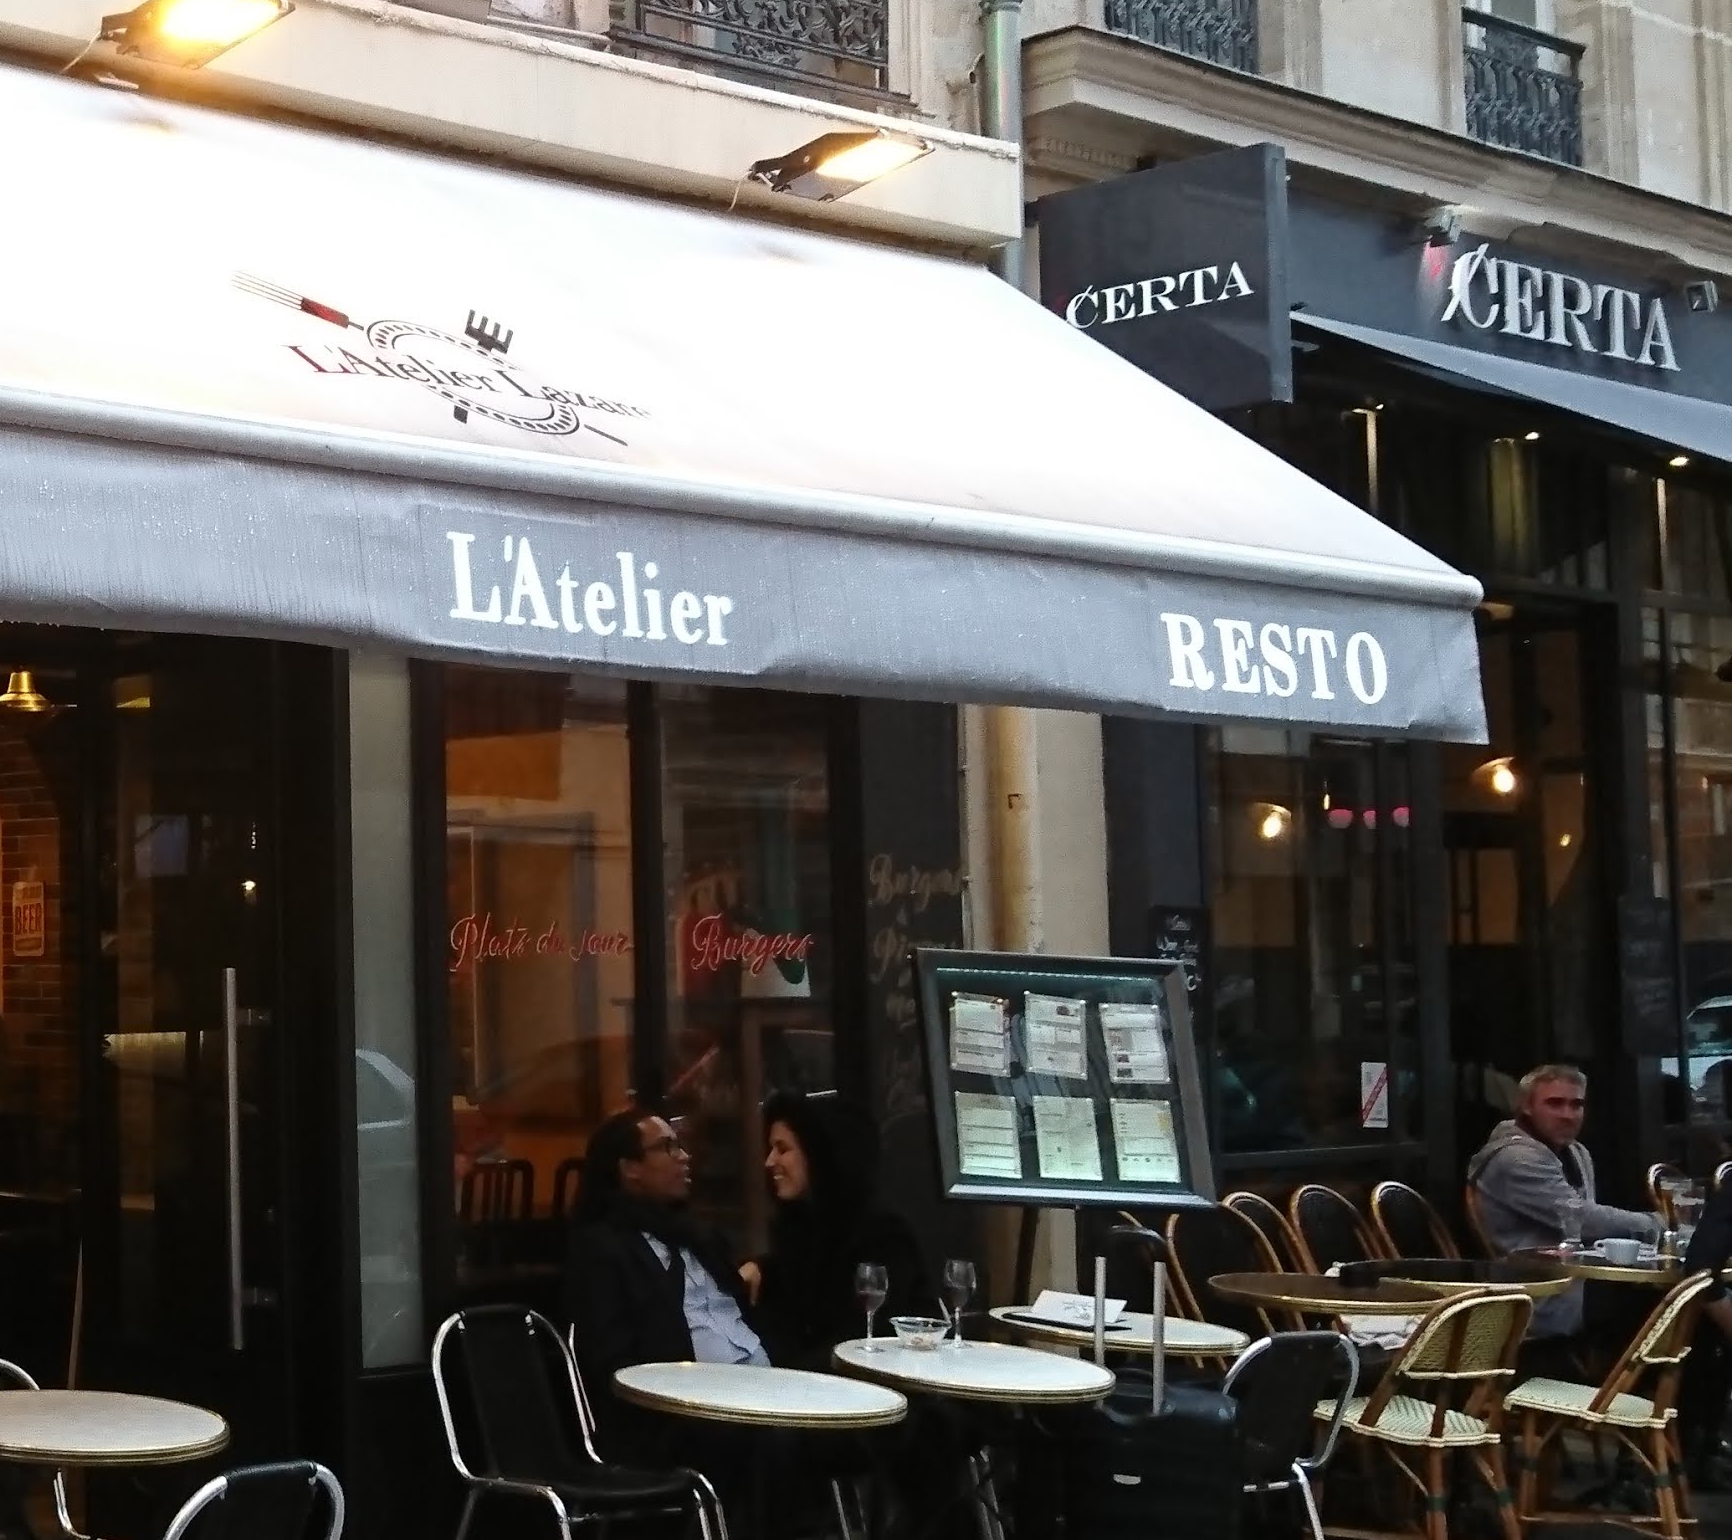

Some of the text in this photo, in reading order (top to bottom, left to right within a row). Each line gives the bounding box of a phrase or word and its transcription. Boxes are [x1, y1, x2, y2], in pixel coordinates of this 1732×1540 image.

[1065, 260, 1256, 331] CERTA
[1440, 242, 1684, 373] CERTA
[288, 344, 500, 393] L'Atelier
[445, 530, 734, 647] L'Atelier
[1159, 611, 1389, 706] RESTO
[14, 902, 42, 935] BEER
[690, 911, 816, 978] Burgers
